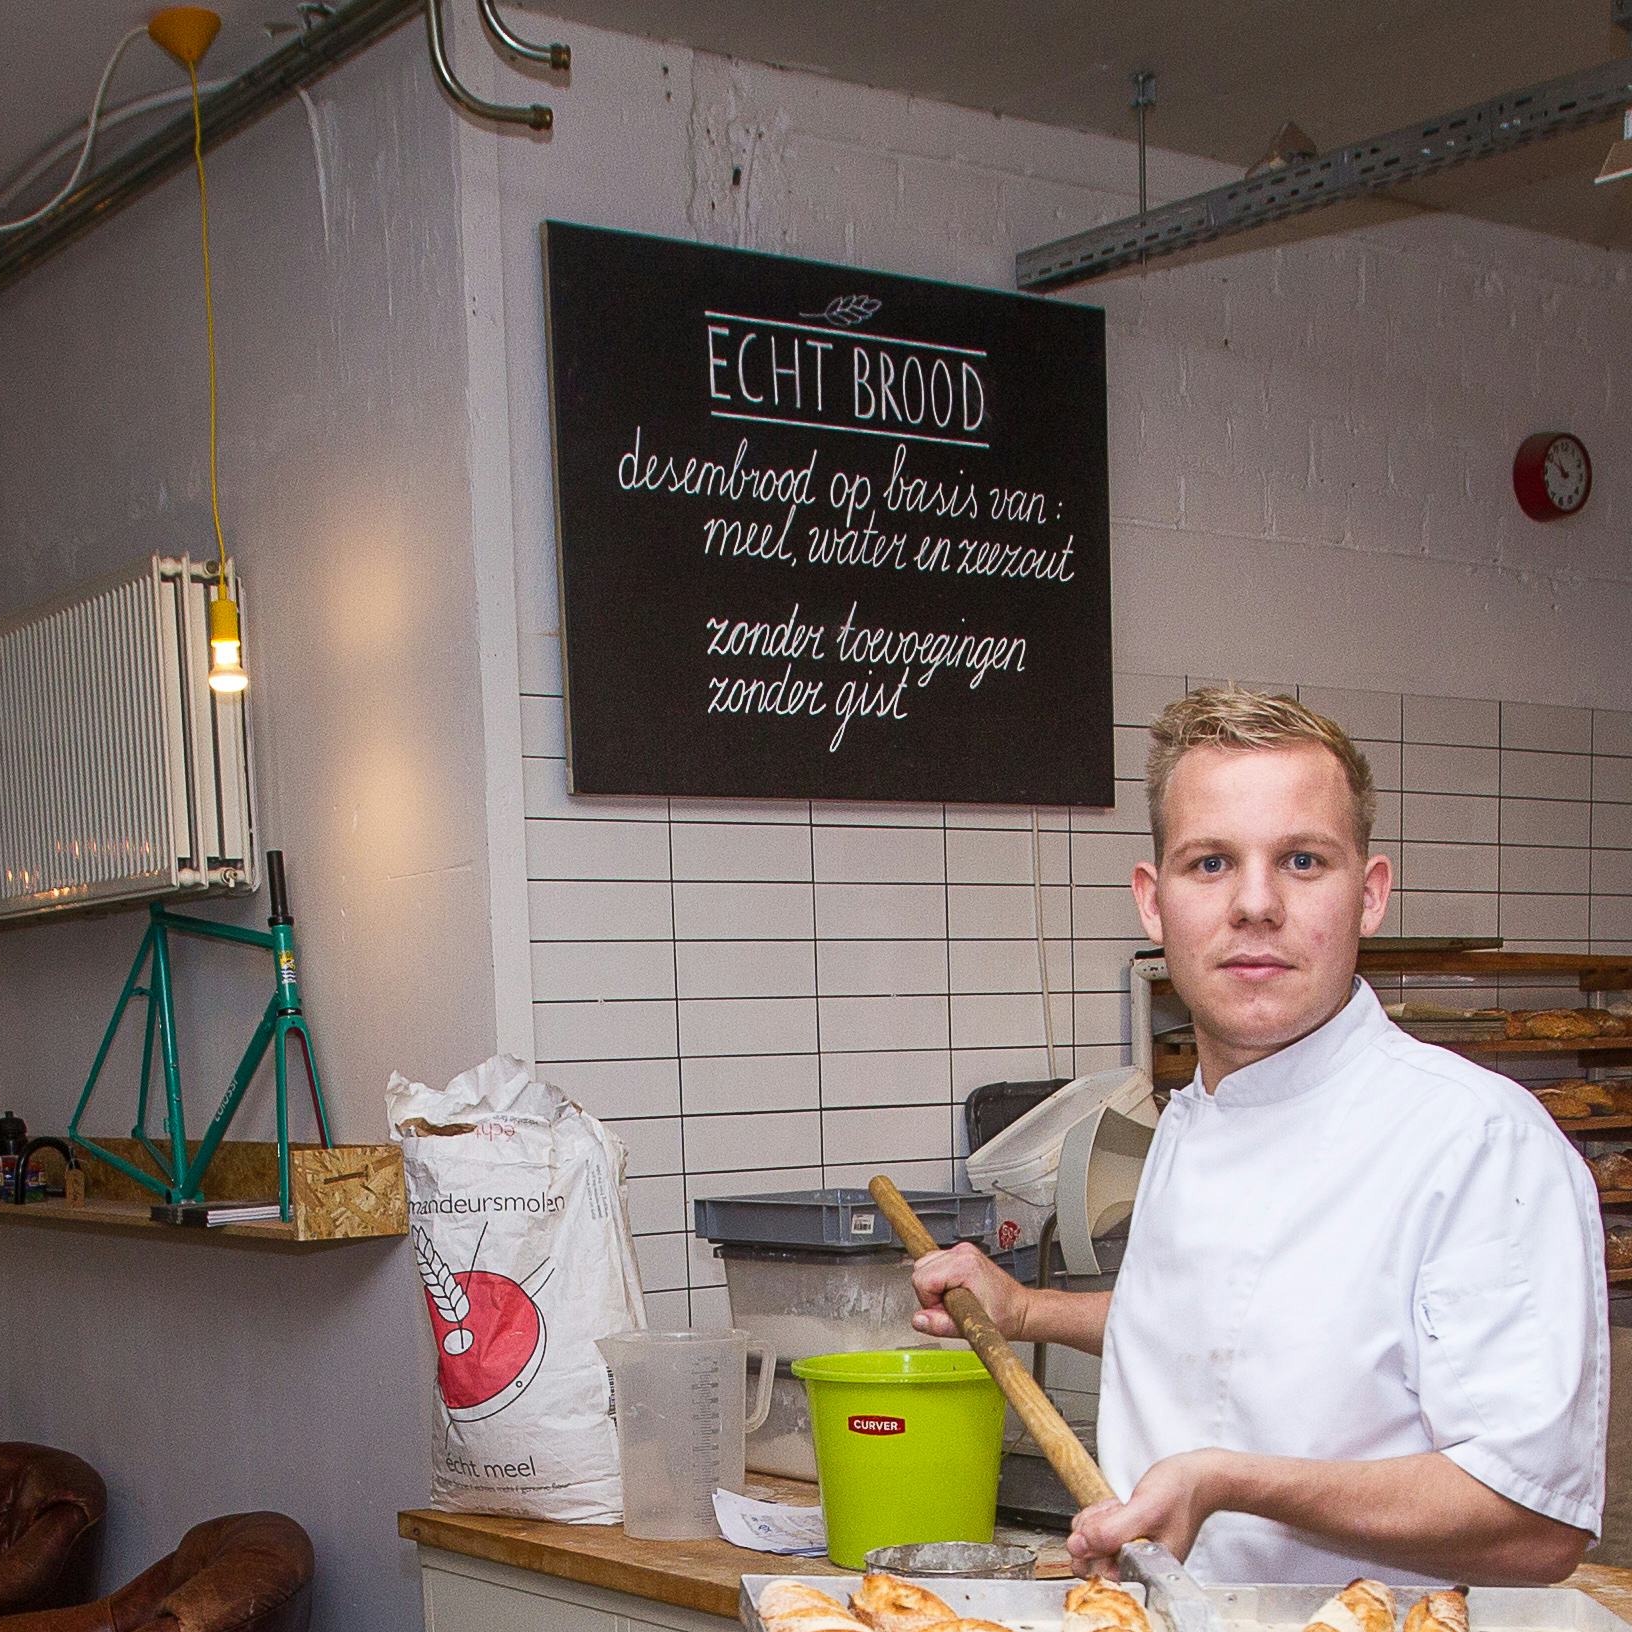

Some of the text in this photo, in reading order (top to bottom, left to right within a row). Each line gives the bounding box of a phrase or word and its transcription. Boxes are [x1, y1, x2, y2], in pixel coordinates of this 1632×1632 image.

[707, 324, 986, 432] ECHT BROOD
[617, 425, 816, 504] desembrood
[829, 470, 871, 528] op
[883, 443, 979, 519] basis
[703, 503, 1075, 583] meel, water en zeezout
[706, 600, 1026, 689] zonder toevoegingen
[708, 662, 908, 753] zonder gist
[408, 1191, 566, 1215] mandeursmolen
[445, 1452, 537, 1478] écht meel
[853, 1419, 899, 1431] CURVER
